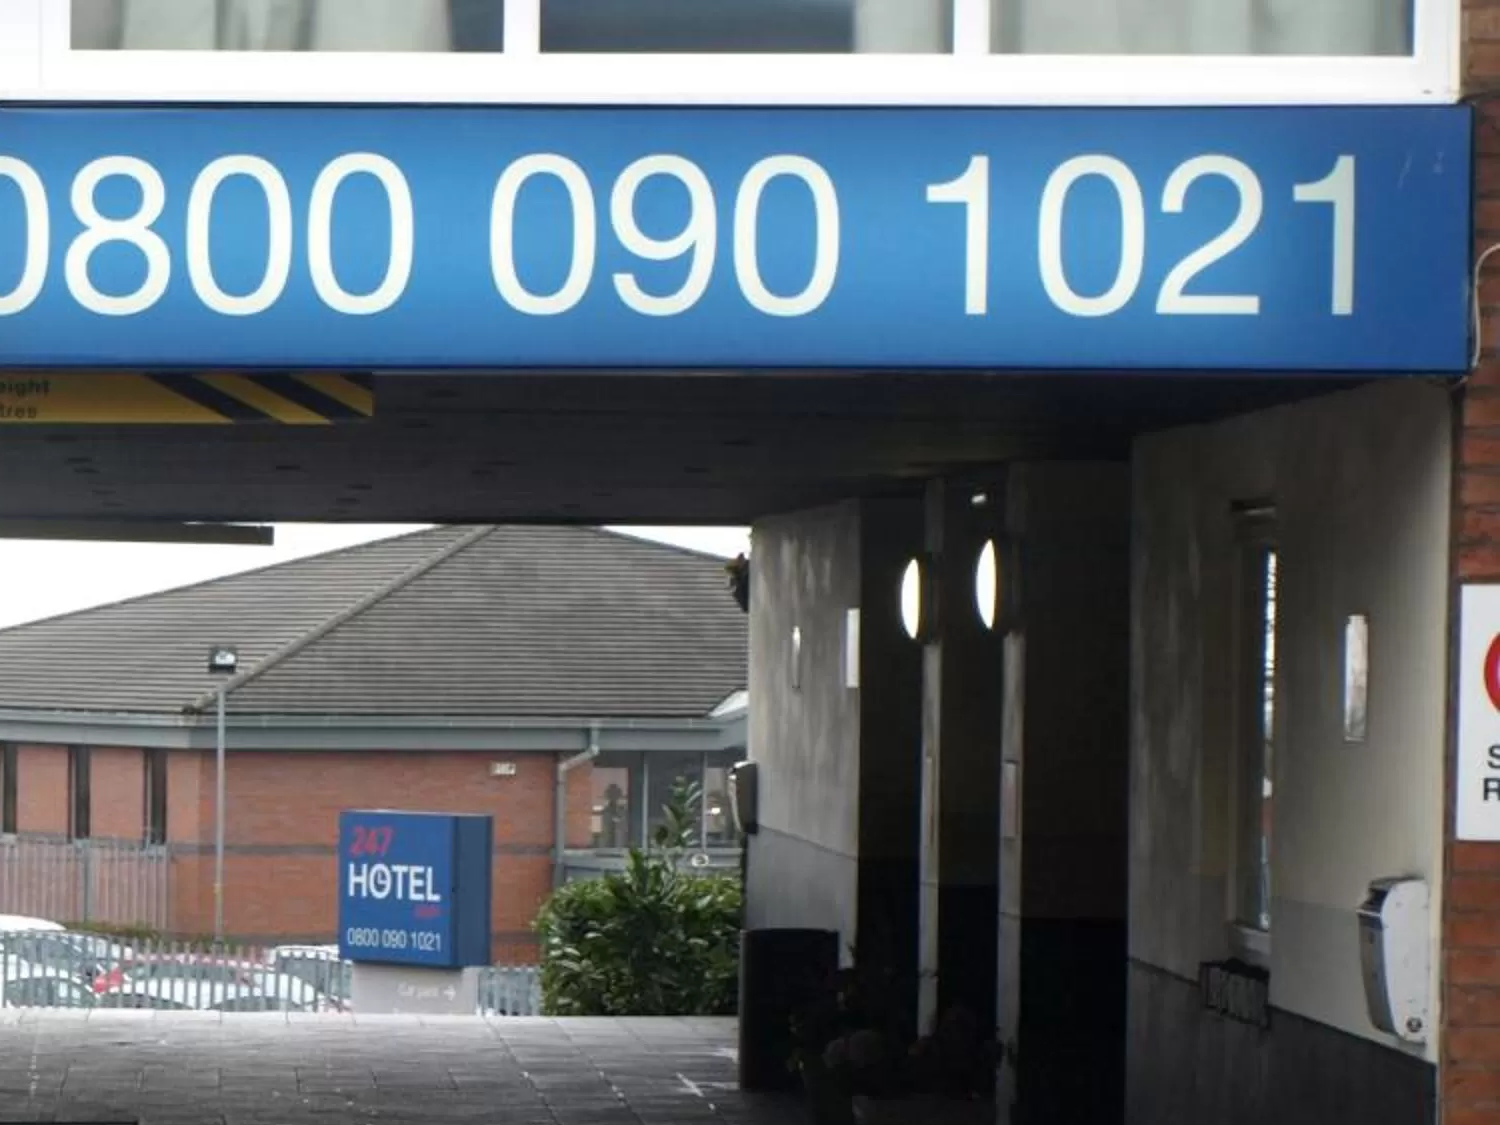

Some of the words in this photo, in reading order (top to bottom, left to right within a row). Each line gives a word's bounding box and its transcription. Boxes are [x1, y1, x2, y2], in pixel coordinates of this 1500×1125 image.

[489, 153, 840, 316] 090
[925, 154, 1356, 317] 1021
[350, 825, 394, 857] 247
[349, 862, 441, 902] HOTEL
[348, 927, 379, 947] 0800
[382, 929, 407, 949] 090
[411, 931, 441, 952] 1021
